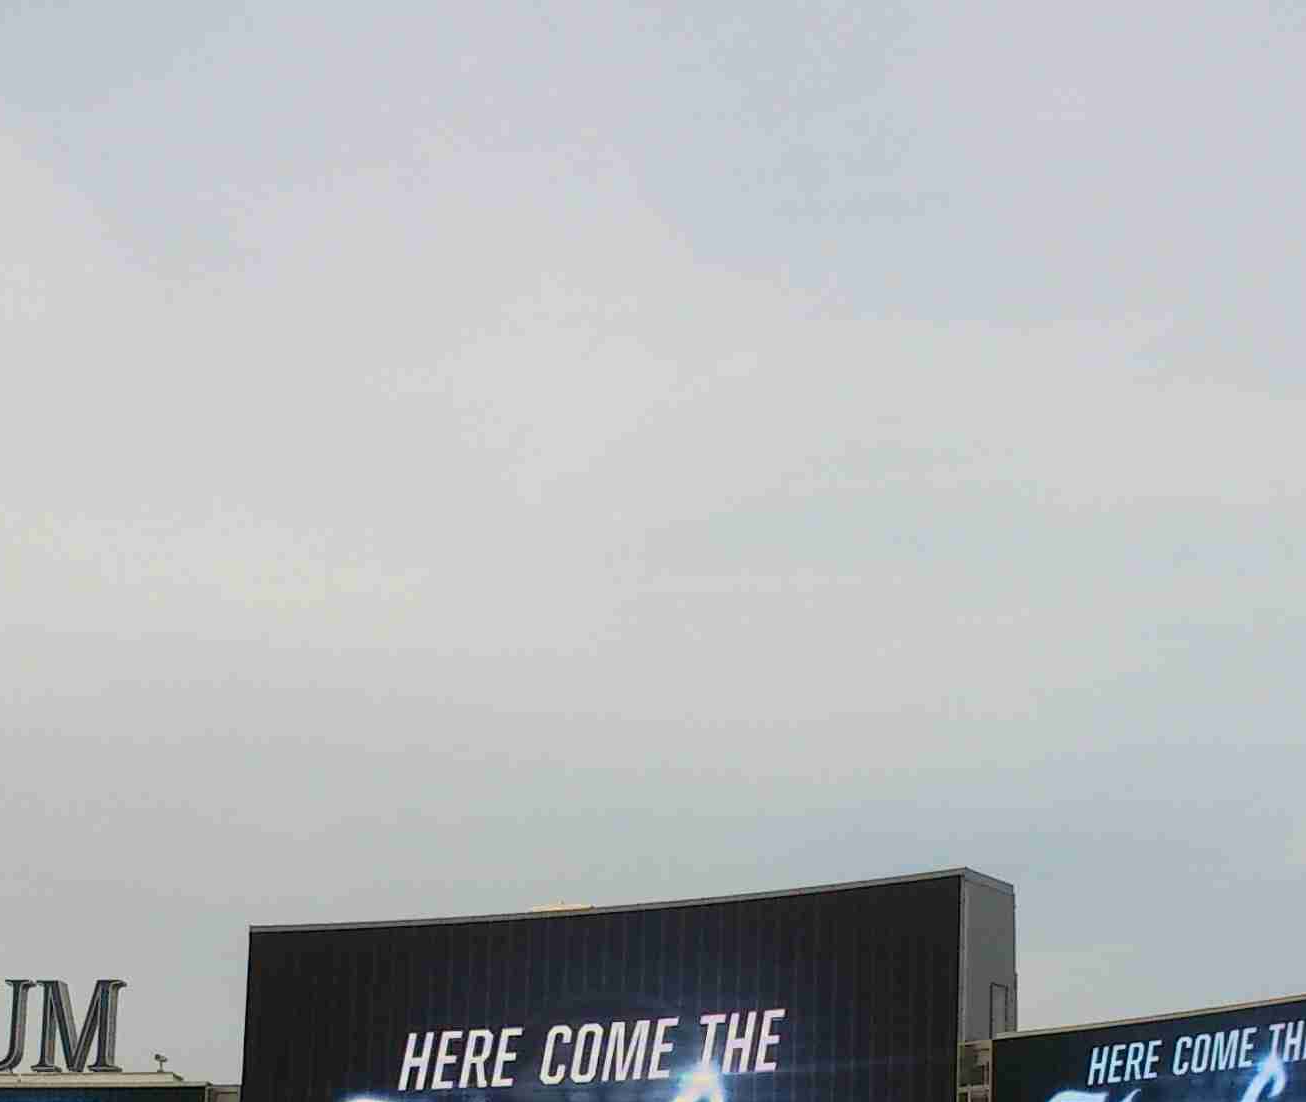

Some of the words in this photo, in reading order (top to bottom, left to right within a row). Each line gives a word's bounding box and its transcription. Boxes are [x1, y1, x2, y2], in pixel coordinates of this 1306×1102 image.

[398, 1027, 523, 1092] HERE
[539, 1016, 679, 1086] COME
[697, 1008, 785, 1075] THE
[1088, 1040, 1162, 1085] HERE
[1172, 1026, 1257, 1076] COME
